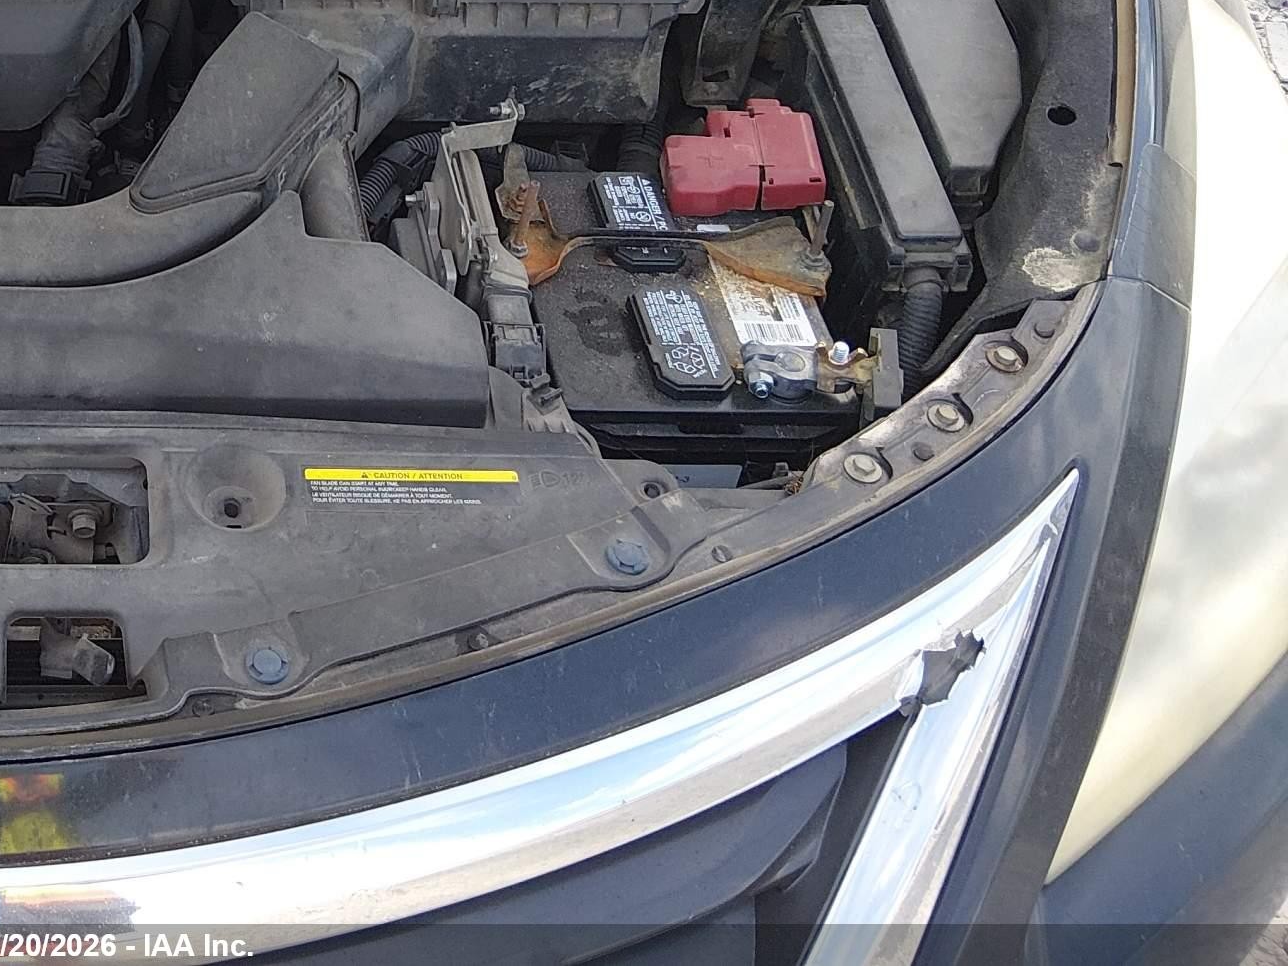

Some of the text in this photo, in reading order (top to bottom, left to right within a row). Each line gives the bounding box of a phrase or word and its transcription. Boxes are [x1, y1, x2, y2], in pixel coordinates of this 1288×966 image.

[644, 186, 662, 215] DANGER
[374, 472, 410, 480] CAUTION
[418, 472, 463, 480] ATTENTION
